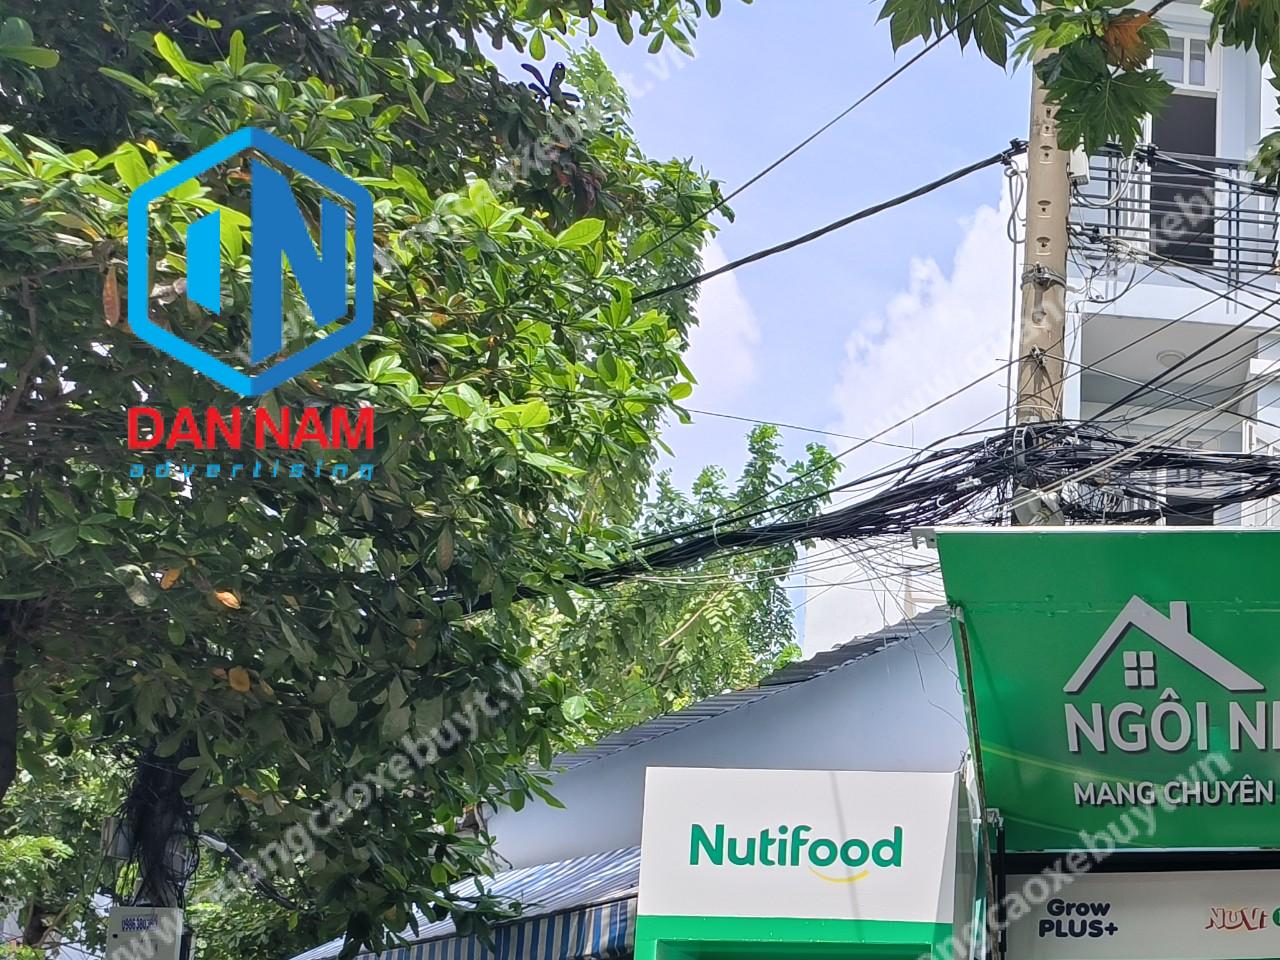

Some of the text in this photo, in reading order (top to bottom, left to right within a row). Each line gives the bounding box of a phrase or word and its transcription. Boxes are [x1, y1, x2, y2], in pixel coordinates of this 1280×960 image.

[1064, 687, 1209, 753] NGÔI
[1073, 782, 1156, 806] MANG
[1164, 774, 1274, 804] CHUYÊN
[689, 823, 903, 867] Nutifood
[1046, 899, 1111, 917] Grow
[1038, 919, 1118, 938] PLUS+
